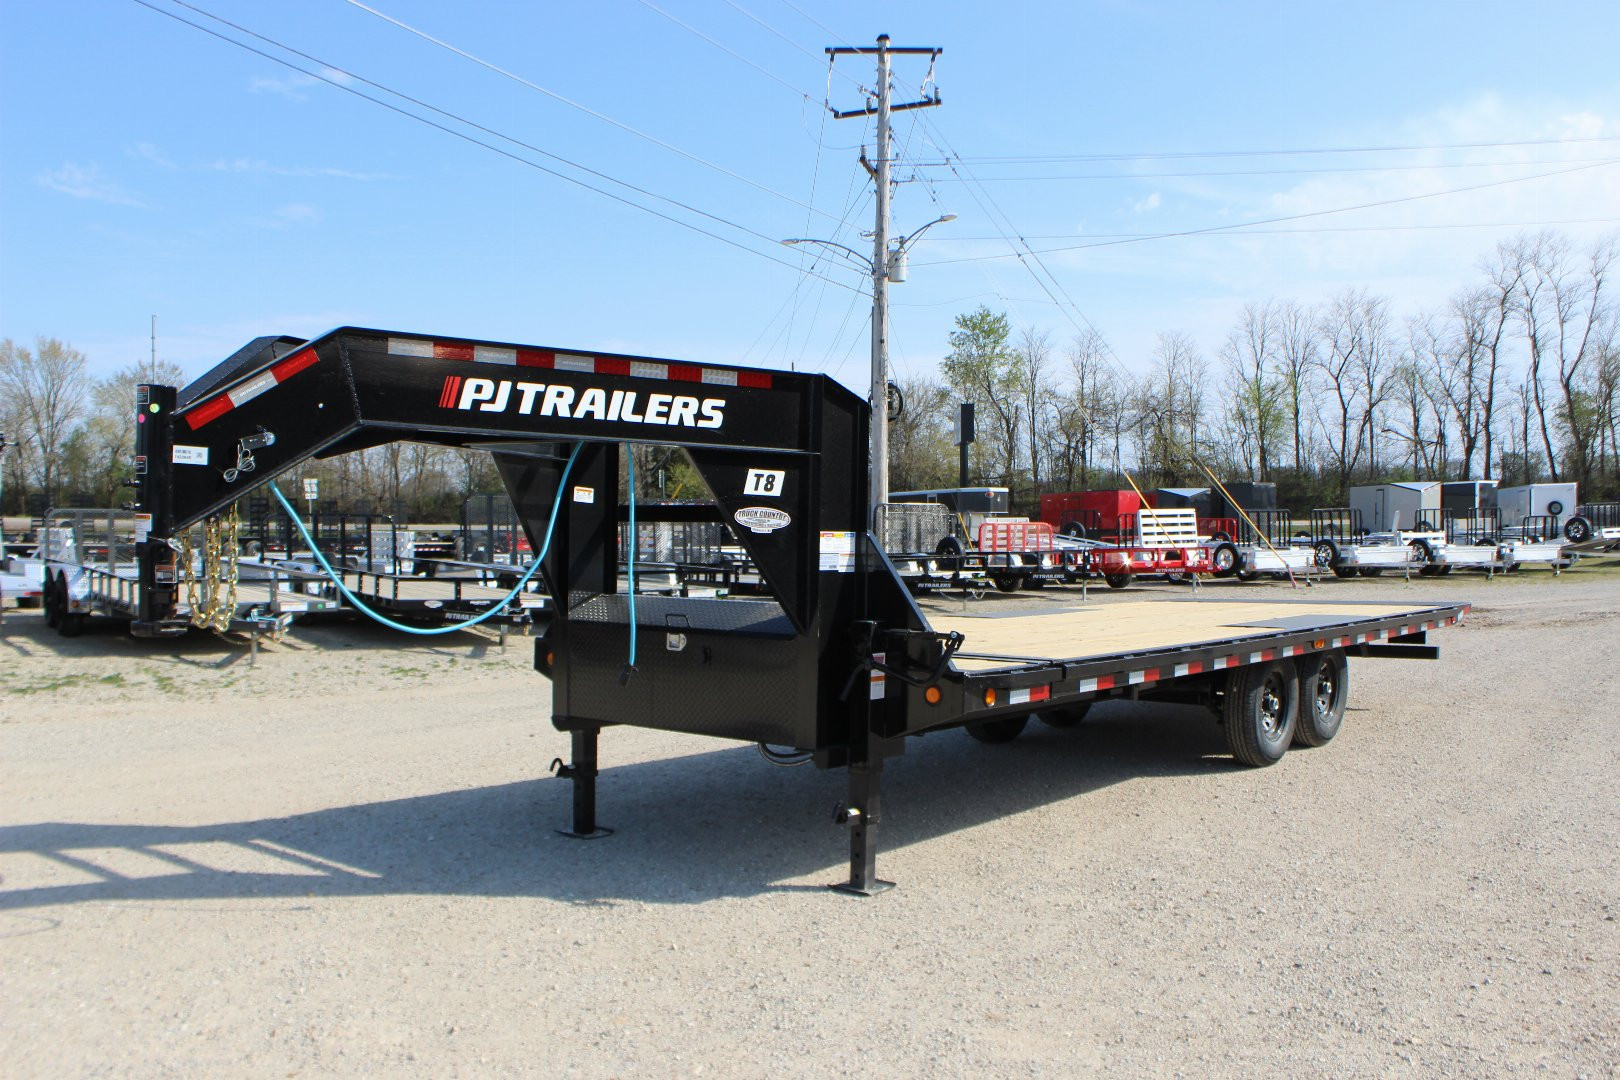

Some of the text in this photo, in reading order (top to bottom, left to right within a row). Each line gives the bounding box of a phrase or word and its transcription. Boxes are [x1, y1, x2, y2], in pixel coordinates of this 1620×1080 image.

[457, 377, 726, 429] PJ TRAILERS
[753, 473, 776, 492] T8
[738, 510, 758, 518] TRUCK
[759, 510, 786, 521] COUNTRY
